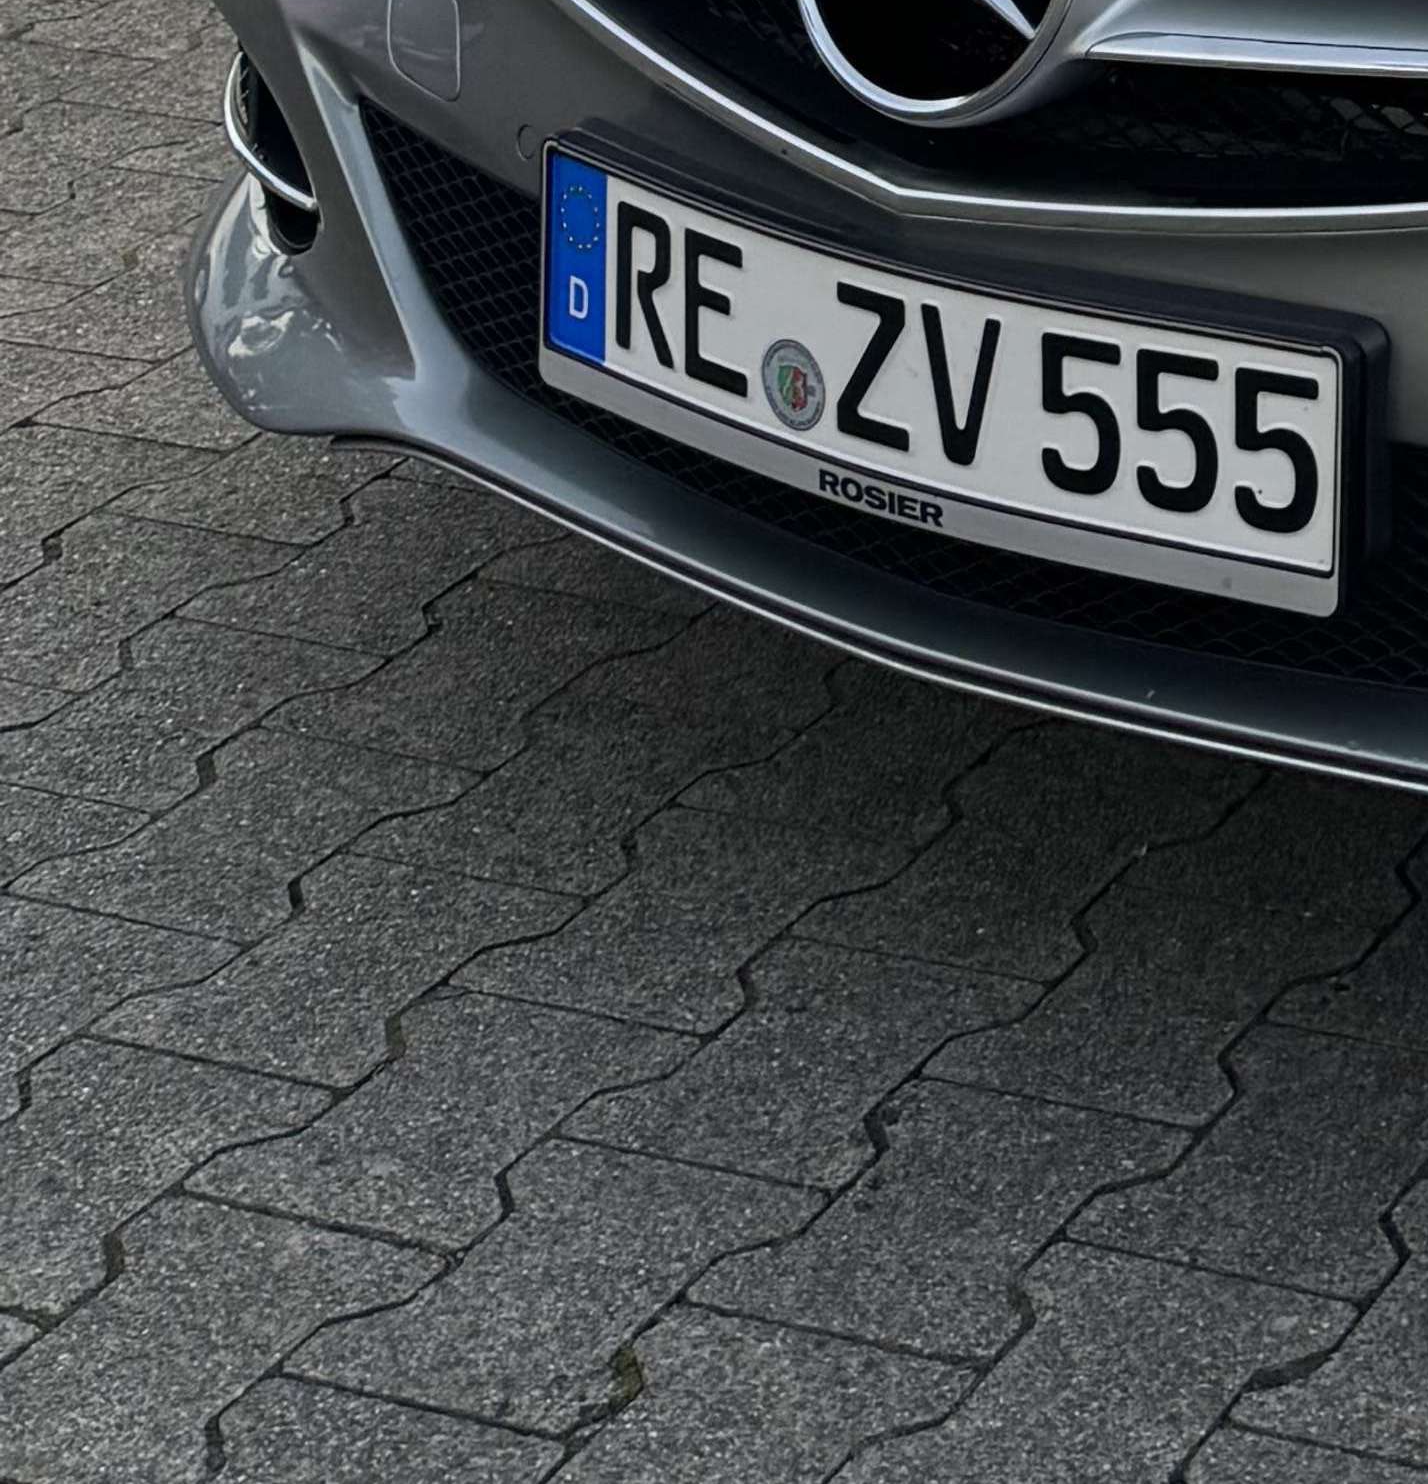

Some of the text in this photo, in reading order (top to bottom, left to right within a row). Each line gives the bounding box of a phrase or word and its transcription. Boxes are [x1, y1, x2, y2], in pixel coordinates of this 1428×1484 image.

[569, 275, 589, 320] D
[615, 200, 749, 398] RE
[836, 281, 1002, 467] ZV
[1041, 332, 1320, 534] 555
[818, 468, 944, 528] ROSIER
